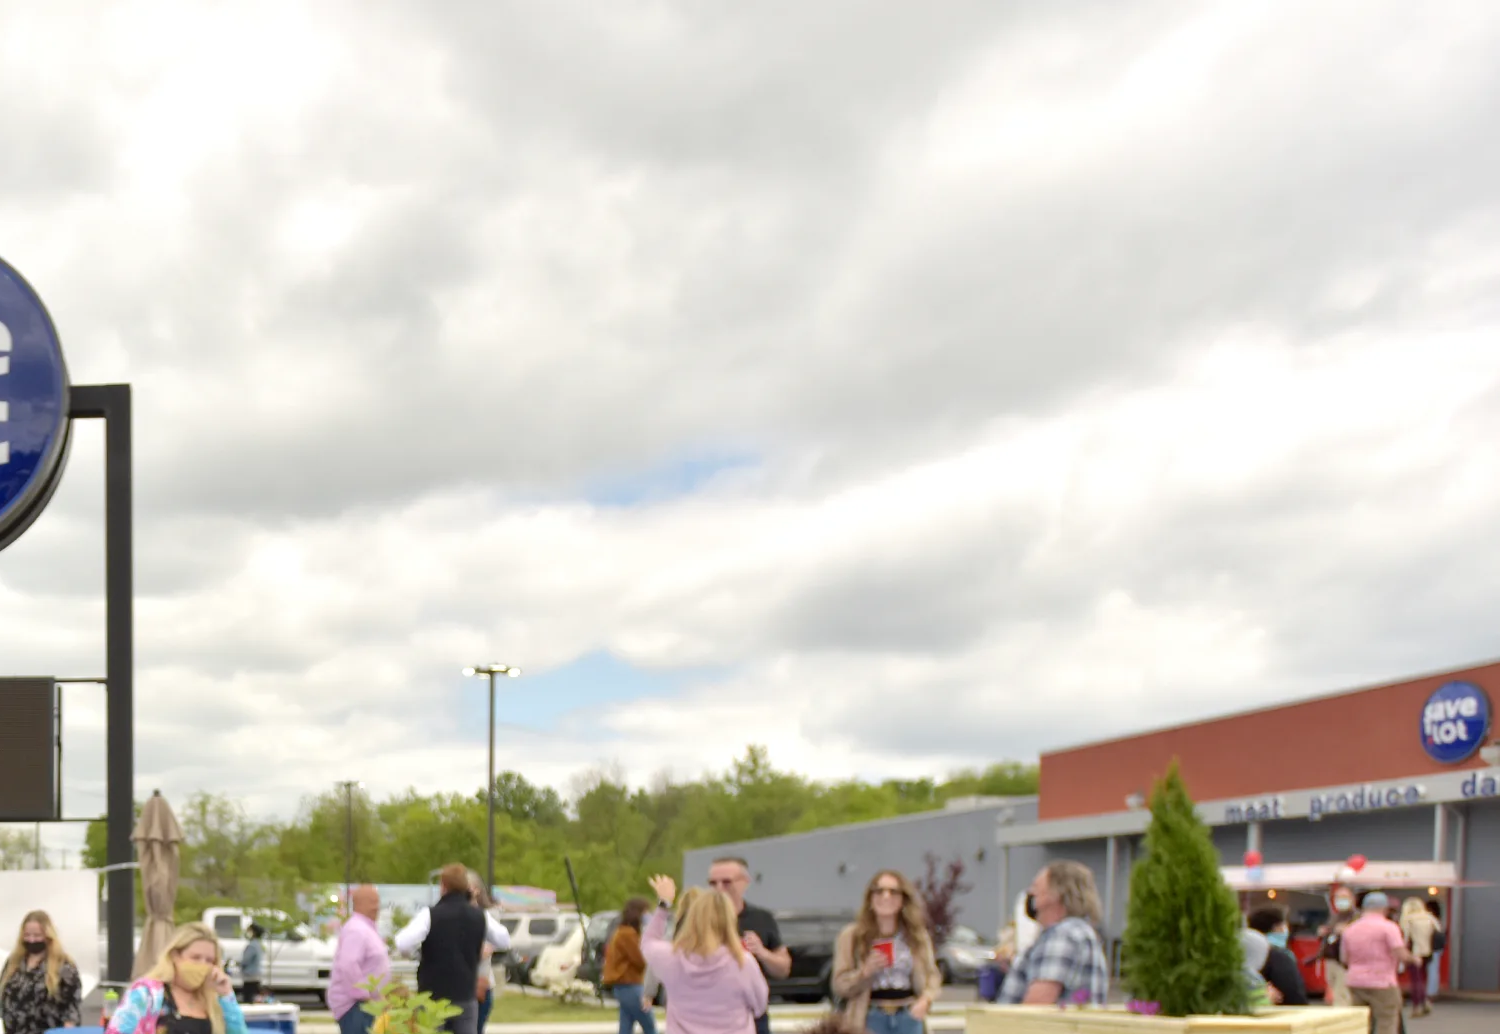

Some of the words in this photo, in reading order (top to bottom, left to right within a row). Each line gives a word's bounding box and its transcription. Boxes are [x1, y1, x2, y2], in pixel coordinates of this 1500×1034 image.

[1423, 696, 1478, 722] save
[1224, 798, 1282, 823] meat
[1309, 784, 1421, 821] produce
